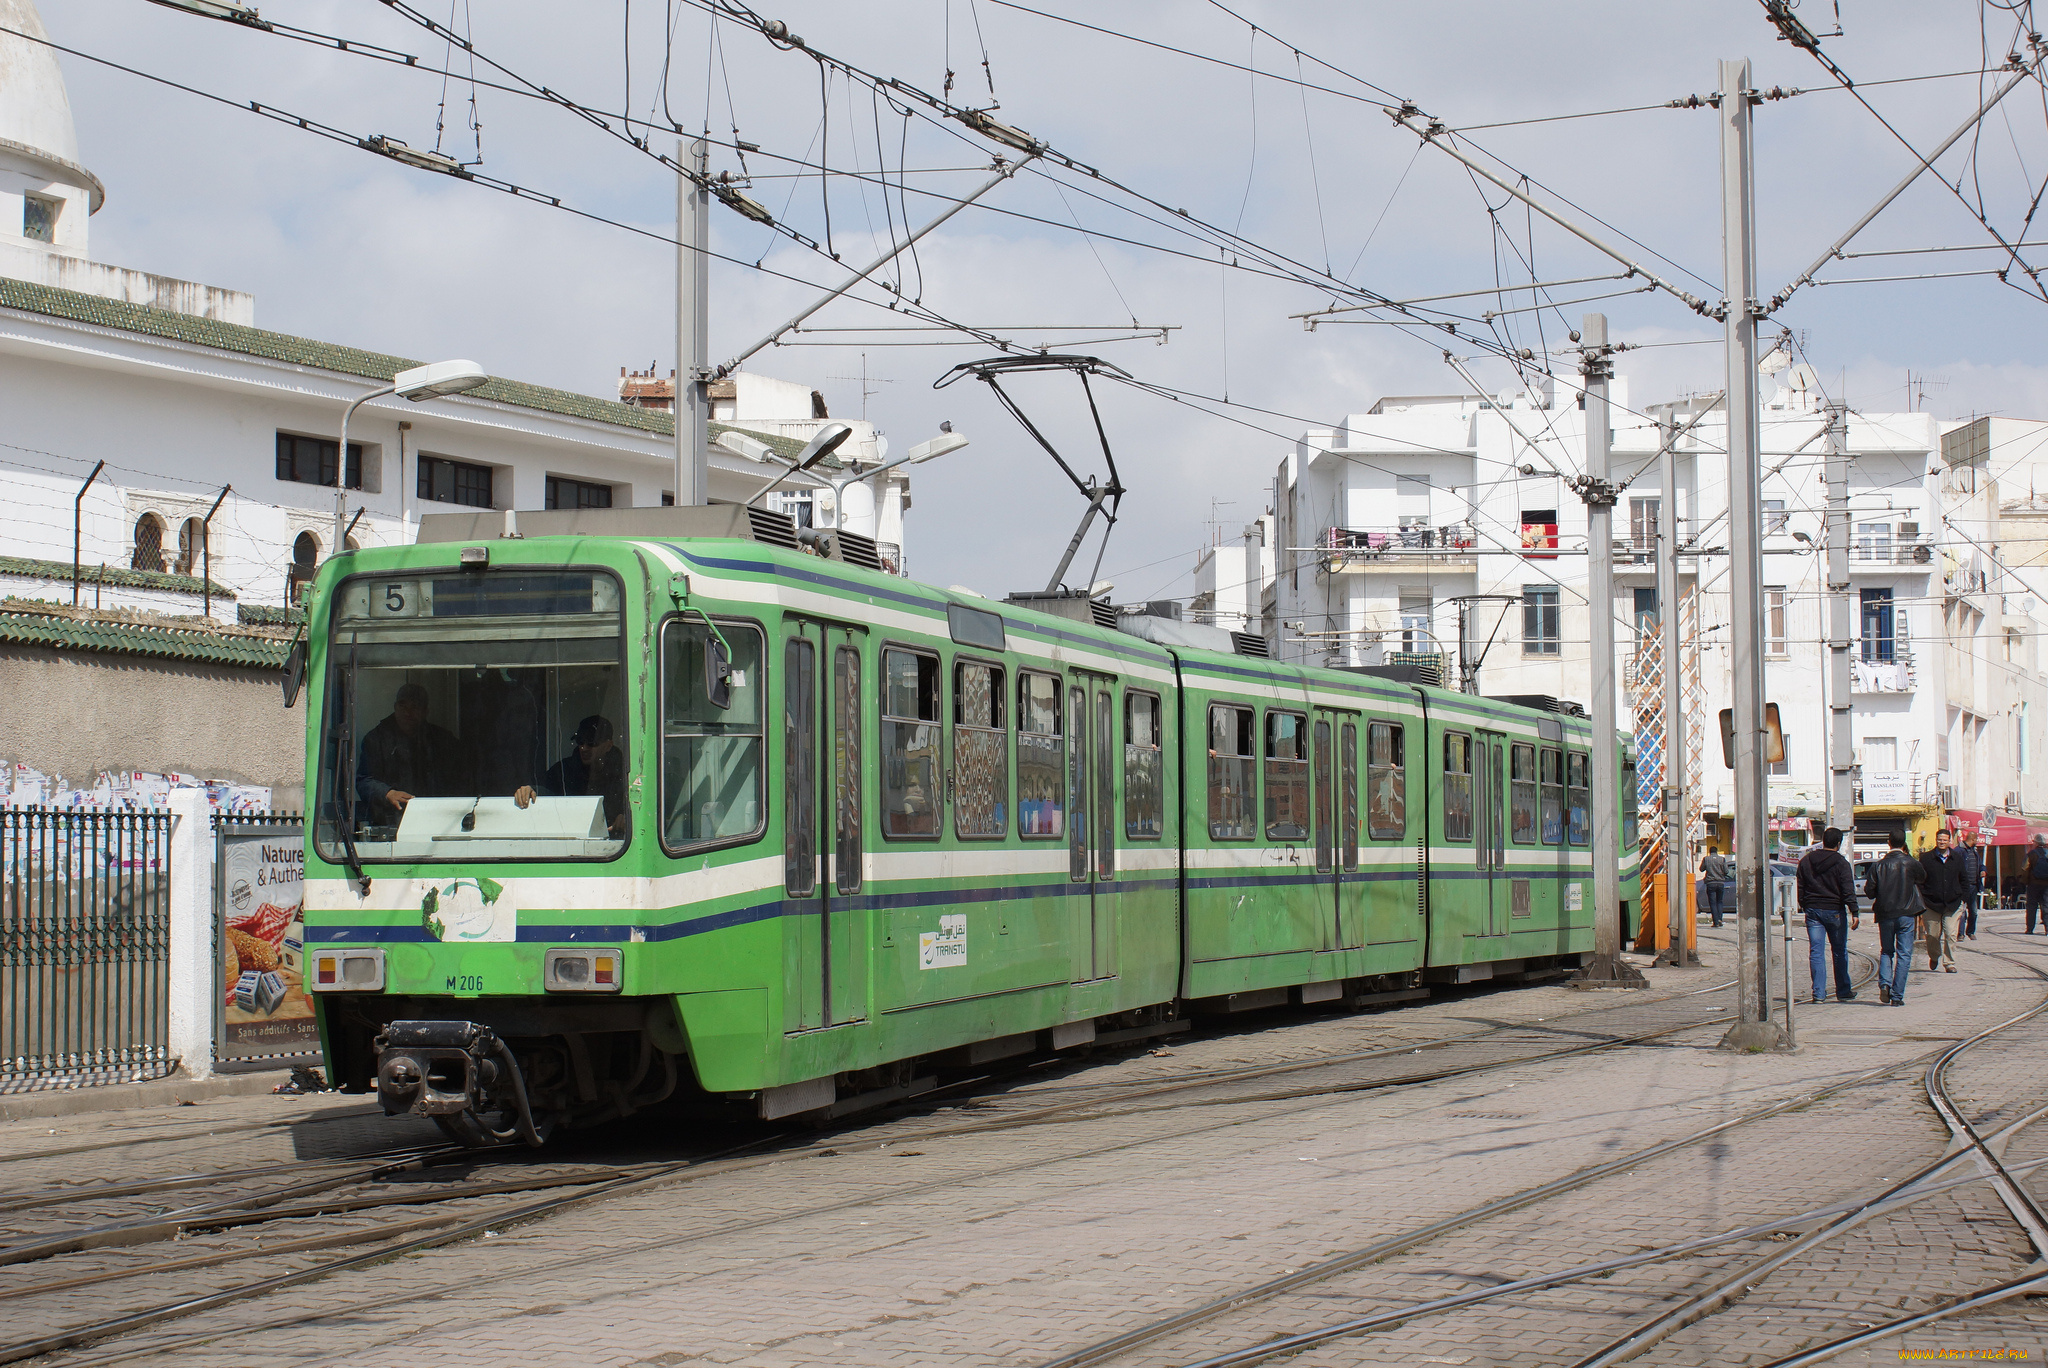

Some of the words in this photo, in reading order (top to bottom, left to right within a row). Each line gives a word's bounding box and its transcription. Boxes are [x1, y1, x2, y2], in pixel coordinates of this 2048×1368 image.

[386, 585, 405, 612] 5
[261, 844, 304, 863] Nature
[257, 868, 266, 887] &
[953, 924, 965, 939] نقل
[936, 944, 965, 956] TRANSTU
[446, 976, 456, 990] M
[460, 975, 483, 991] 206
[238, 1027, 257, 1038] Sans
[259, 1023, 290, 1036] additifs
[297, 1023, 315, 1033] Sans
